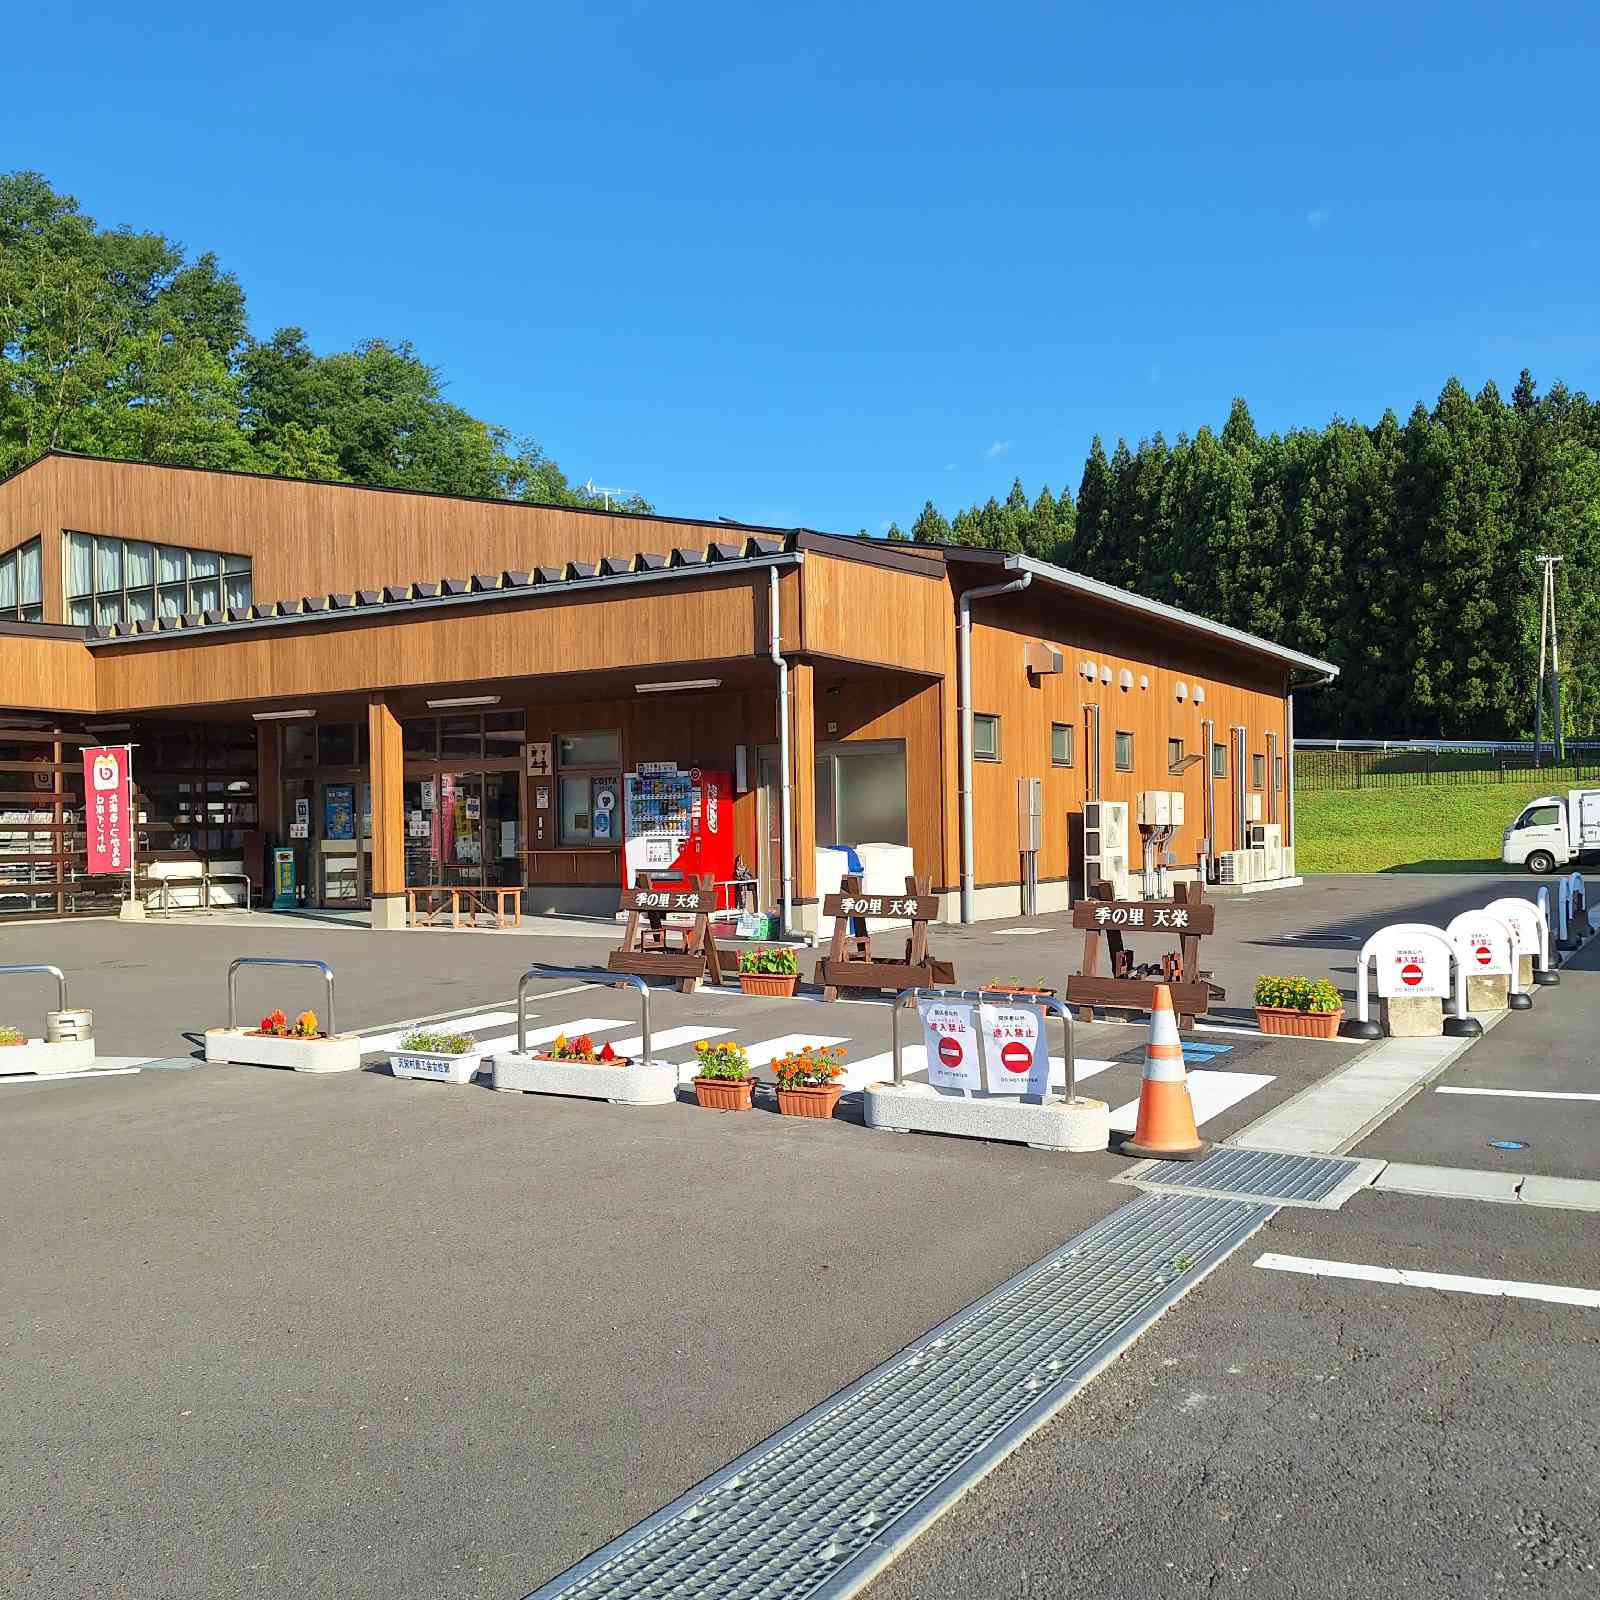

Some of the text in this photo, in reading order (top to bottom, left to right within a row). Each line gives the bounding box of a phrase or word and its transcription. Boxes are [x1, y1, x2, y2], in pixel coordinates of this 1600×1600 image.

[635, 892, 699, 908] 季の里 天栄
[840, 897, 918, 916] 季の里 天栄
[1095, 906, 1188, 928] 季の里 天栄
[928, 1022, 967, 1033] 進入禁止
[992, 1027, 1037, 1038] 進入禁止
